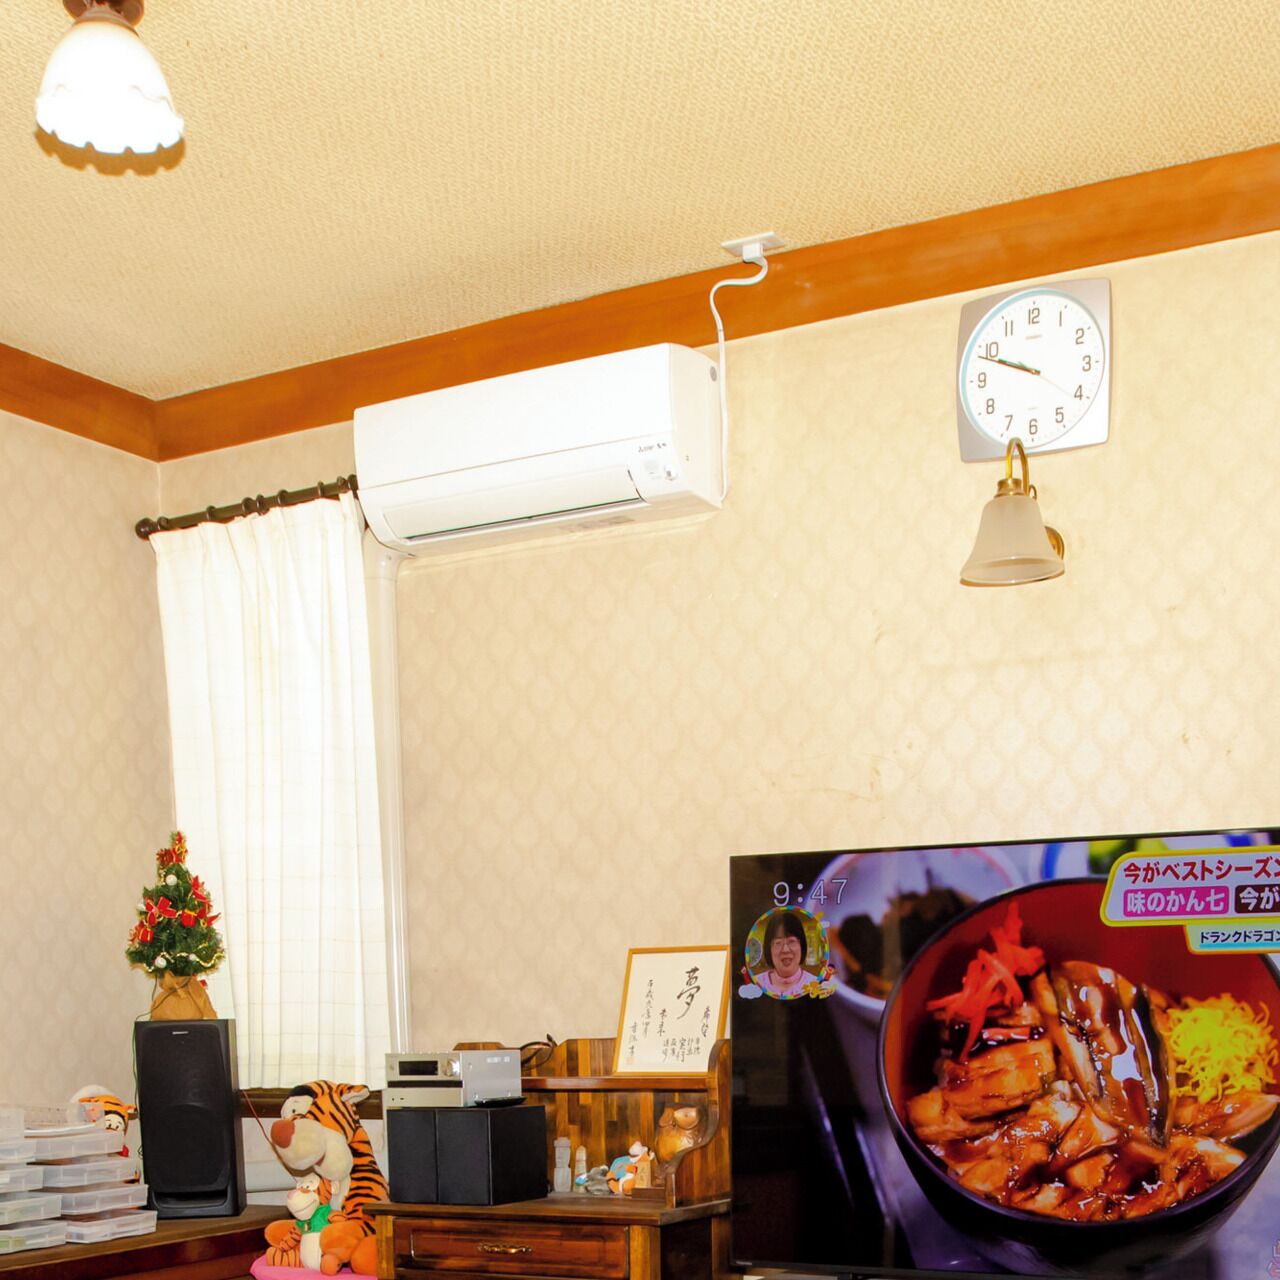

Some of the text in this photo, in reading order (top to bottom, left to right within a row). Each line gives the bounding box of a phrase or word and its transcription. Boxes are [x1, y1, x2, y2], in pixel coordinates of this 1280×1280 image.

[1028, 307, 1040, 325] 12
[1004, 319, 1014, 337] 11
[1075, 327, 1085, 345] 2
[985, 341, 999, 359] 10
[1082, 354, 1092, 372] 3
[977, 372, 987, 389] 9
[1073, 384, 1083, 401] 4
[986, 398, 995, 415] 8
[1055, 406, 1065, 424] 5
[1004, 414, 1014, 431] 7
[1028, 418, 1038, 435] 6
[773, 878, 849, 906] 9:47
[1126, 889, 1224, 915] 味のかん七
[676, 966, 701, 1020] 夢
